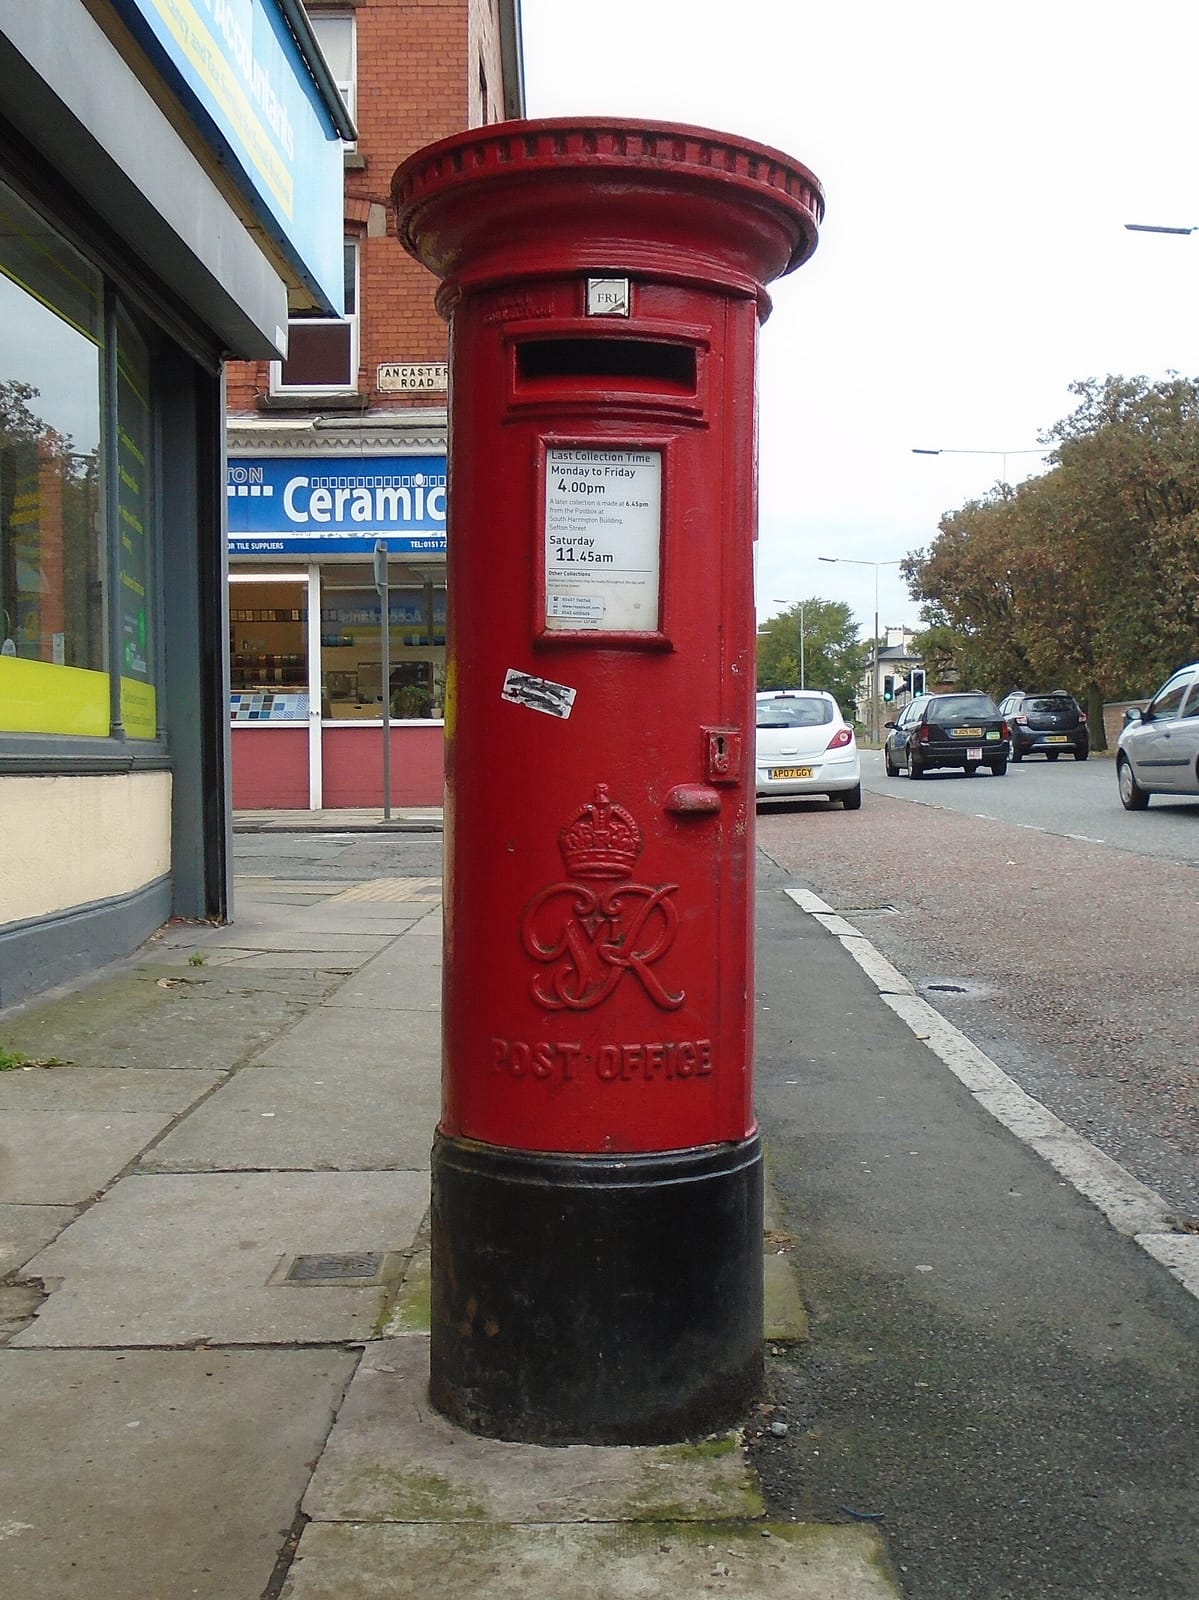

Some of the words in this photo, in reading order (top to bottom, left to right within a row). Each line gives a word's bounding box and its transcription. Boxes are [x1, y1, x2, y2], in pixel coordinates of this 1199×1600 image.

[597, 293, 618, 304] FRI
[384, 367, 449, 378] ANCASTER
[401, 378, 434, 388] ROAD
[551, 450, 573, 461] Last
[575, 451, 624, 462] Collection
[626, 452, 651, 463] Time
[551, 465, 590, 478] Monday
[592, 467, 602, 476] to
[604, 467, 636, 479] Friday
[557, 478, 606, 496] 4.00pm
[283, 473, 447, 523] Ceramic
[567, 517, 599, 525] Harrington
[236, 542, 249, 550] TILE
[251, 542, 284, 550] SUPPLIERS
[549, 535, 595, 548] Saturday
[556, 547, 614, 563] 11.45am
[773, 768, 794, 778] AP07
[796, 767, 812, 777] GGY
[490, 1037, 582, 1082] POST
[594, 1038, 713, 1082] OFFICE
